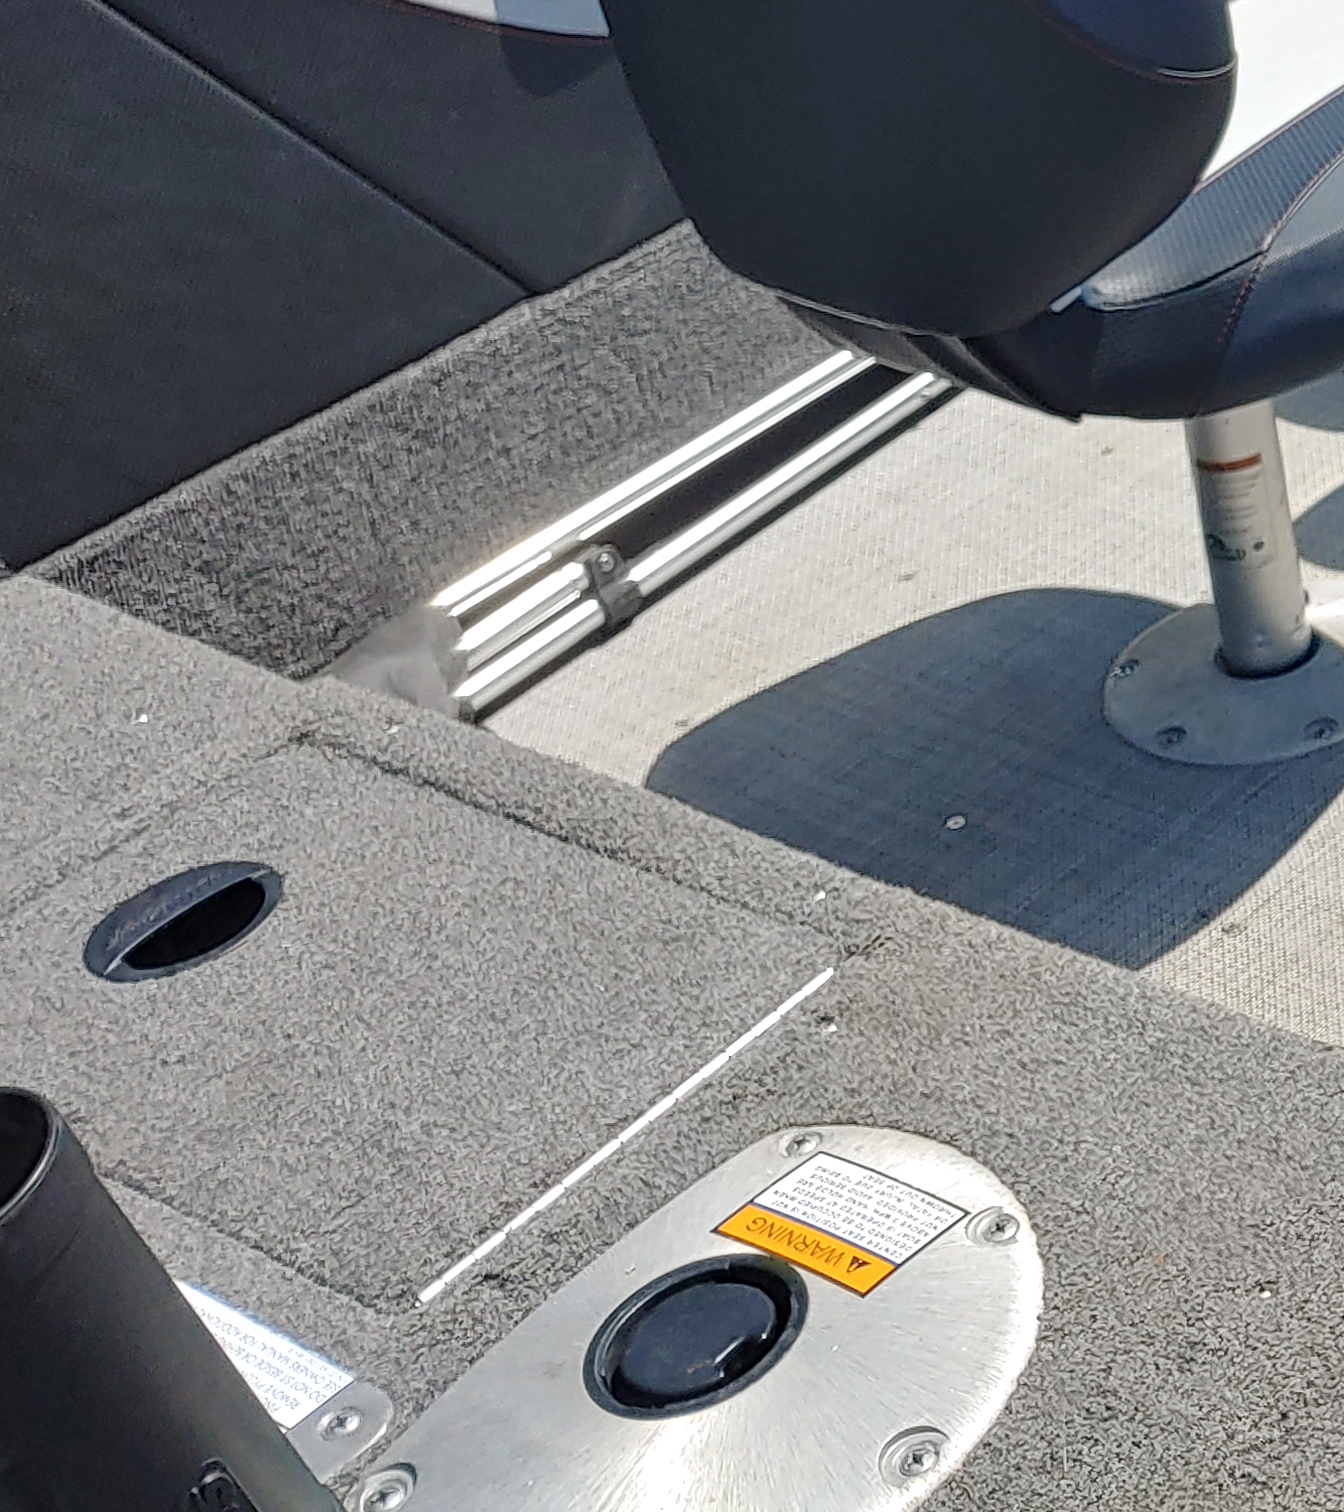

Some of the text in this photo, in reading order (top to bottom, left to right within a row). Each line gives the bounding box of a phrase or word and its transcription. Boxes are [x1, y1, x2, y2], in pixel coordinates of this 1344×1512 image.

[801, 1211, 841, 1231] POSITION
[746, 1217, 844, 1266] WARNING
[842, 1230, 866, 1241] SEAT
[867, 1228, 912, 1252] DESIGNED
[866, 1239, 903, 1259] CENTER
